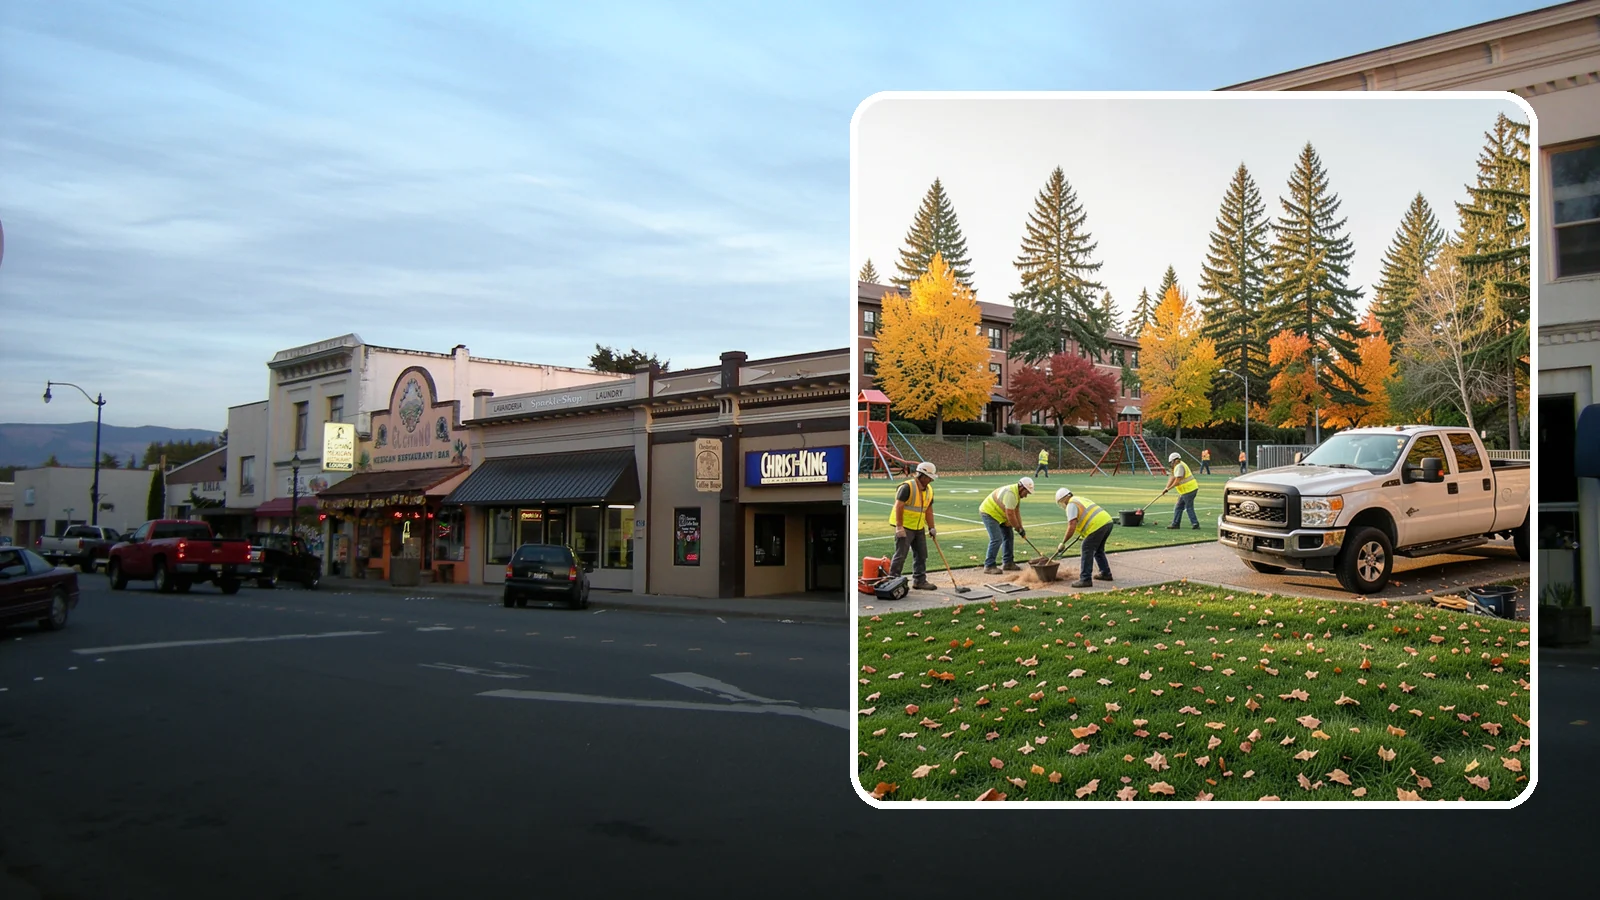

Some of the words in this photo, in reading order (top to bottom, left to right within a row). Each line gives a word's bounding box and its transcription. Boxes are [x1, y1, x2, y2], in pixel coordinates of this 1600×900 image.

[493, 402, 523, 413] LAVANDERIA
[561, 394, 583, 405] Shop
[595, 389, 623, 400] LAUNDRY
[373, 454, 396, 464] MEXICAN
[397, 451, 434, 463] RESTAURANT
[438, 450, 450, 459] BAR
[761, 452, 797, 477] CHRIST
[799, 450, 827, 476] KING
[696, 481, 709, 489] Coffee
[710, 481, 722, 489] House
